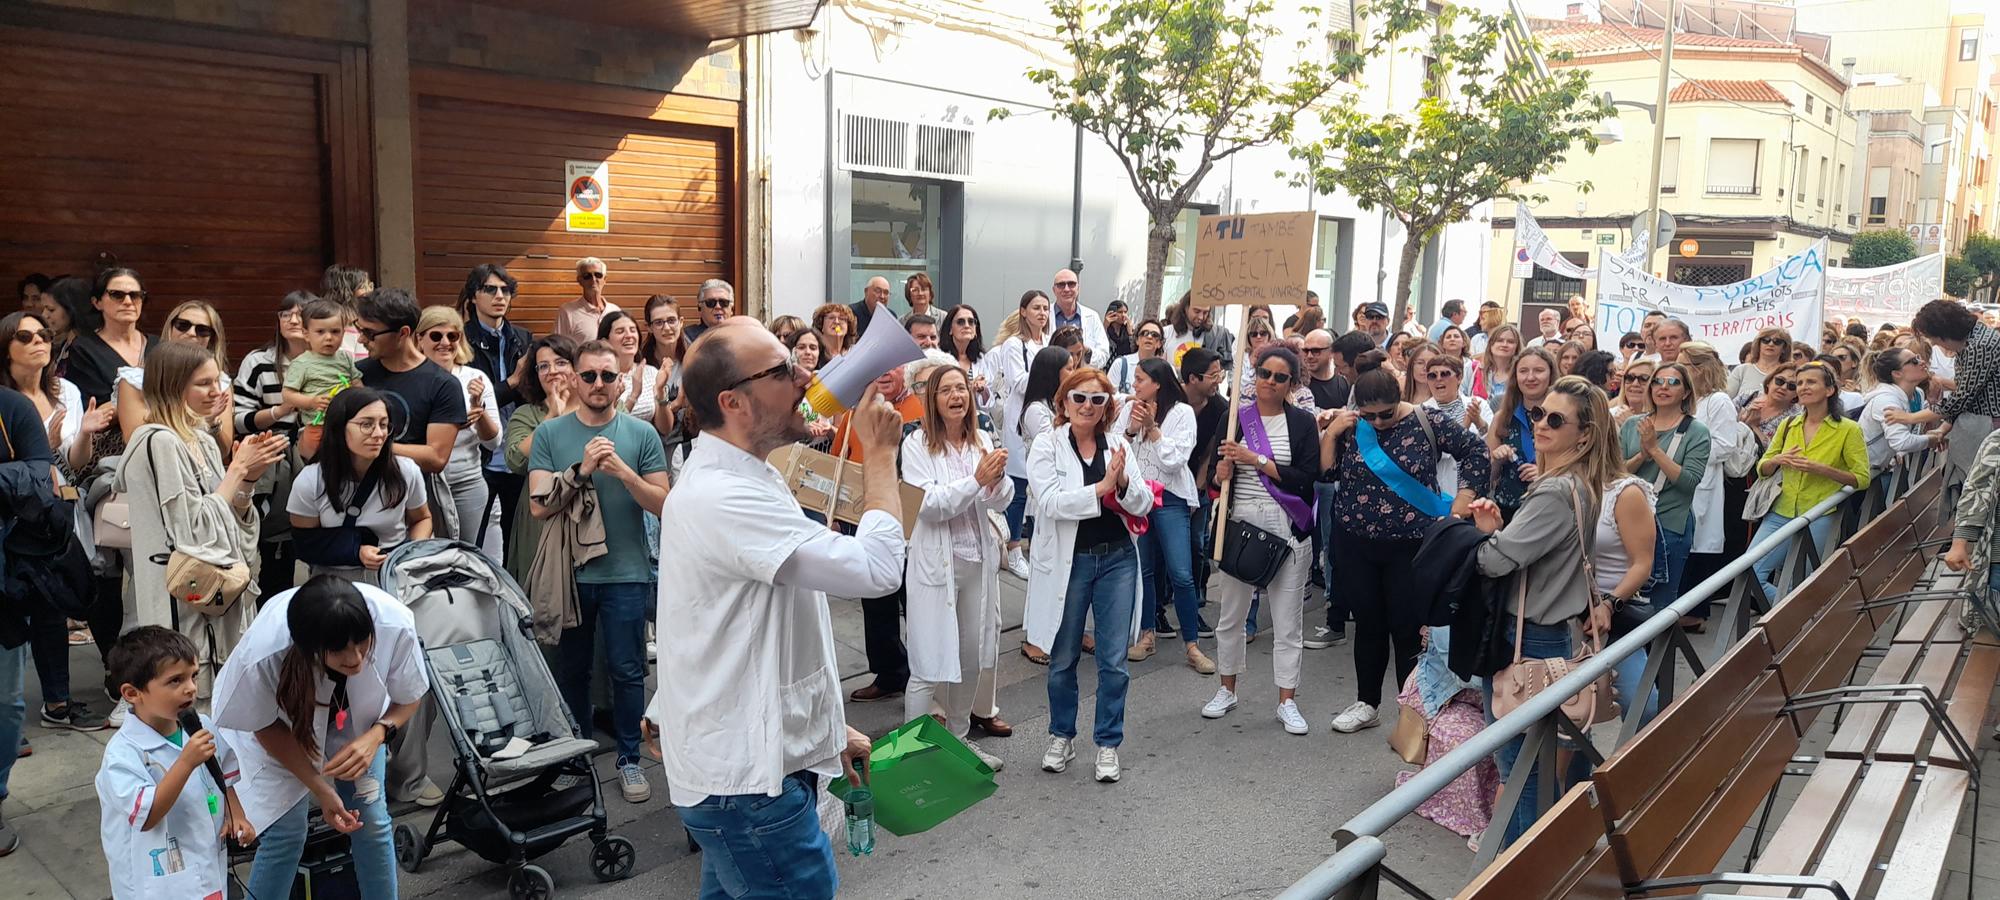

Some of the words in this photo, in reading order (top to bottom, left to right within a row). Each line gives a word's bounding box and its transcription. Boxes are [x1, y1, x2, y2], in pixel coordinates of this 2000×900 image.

[1203, 221, 1213, 241] A
[1215, 217, 1246, 241] TU
[1250, 214, 1302, 237] TAMBÉ
[1198, 248, 1290, 281] T'AFECTA
[1609, 256, 1684, 294] SANIT
[1694, 248, 1823, 301] PÚBLICA
[1228, 286, 1268, 300] HOSPITAL
[1621, 282, 1649, 302] PER
[1657, 295, 1671, 306] A
[1742, 296, 1759, 308] EN
[1756, 300, 1776, 313] ELS
